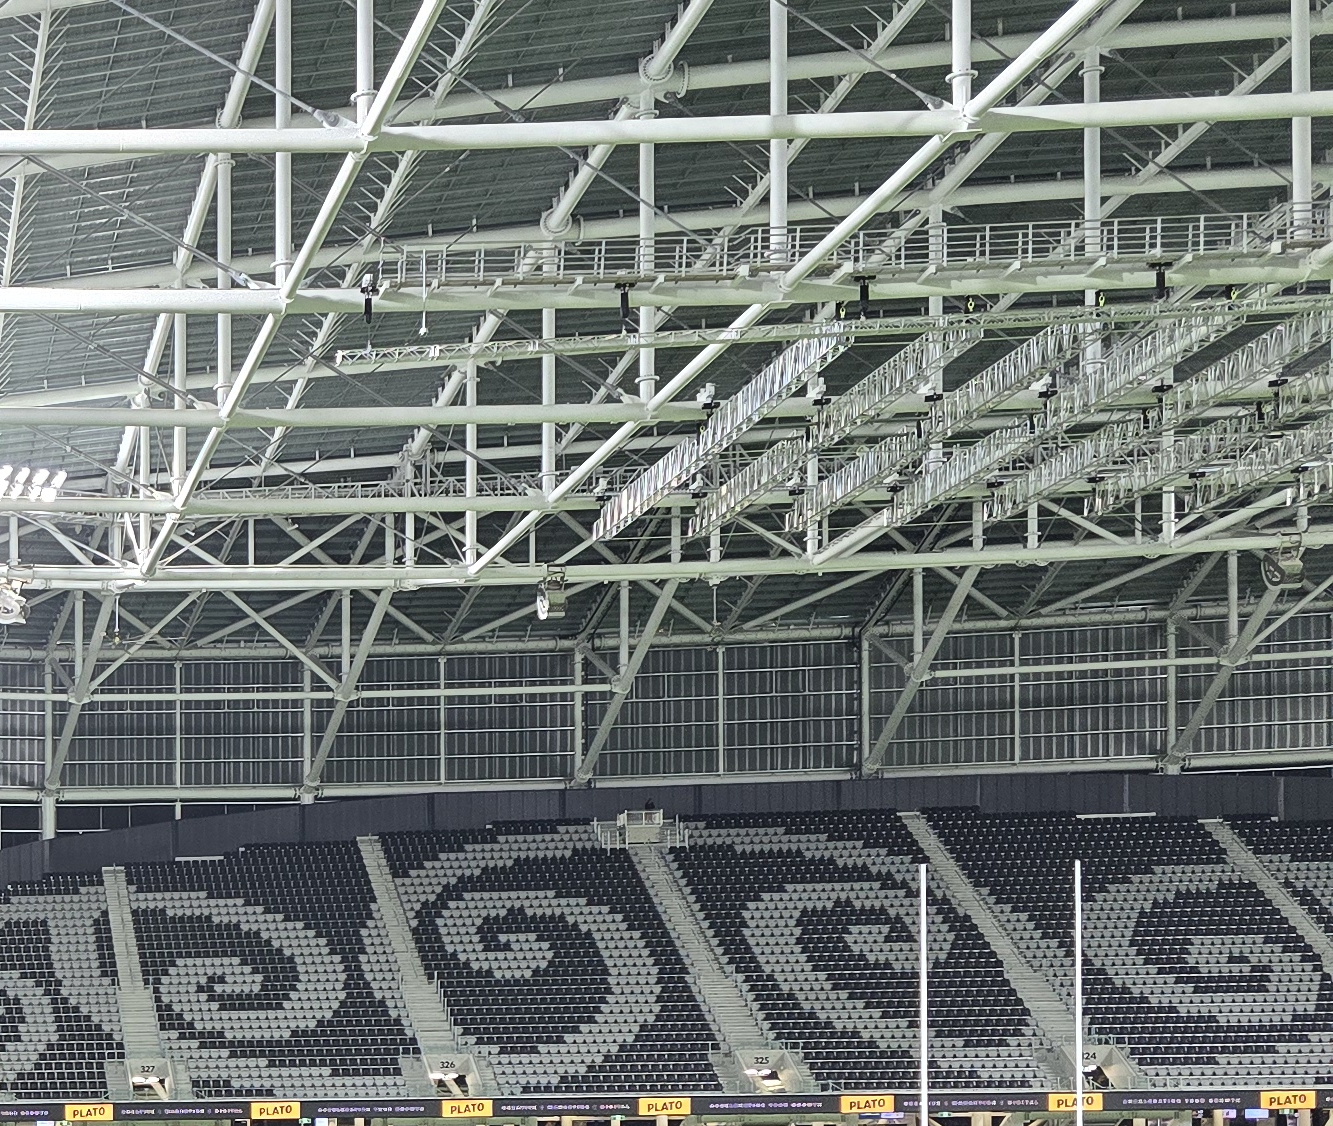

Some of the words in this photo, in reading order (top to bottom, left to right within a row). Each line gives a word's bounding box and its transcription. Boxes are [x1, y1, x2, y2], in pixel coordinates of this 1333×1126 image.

[753, 1056, 770, 1065] 325
[1083, 1052, 1097, 1060] 24
[140, 1065, 155, 1073] 327
[439, 1061, 456, 1069] 326
[647, 1100, 683, 1113] PLATO
[849, 1098, 886, 1111] PLATO
[1269, 1094, 1307, 1107] PLATO
[72, 1106, 106, 1119] PLATO
[259, 1104, 293, 1117] PLATO
[450, 1102, 485, 1115] PLATO
